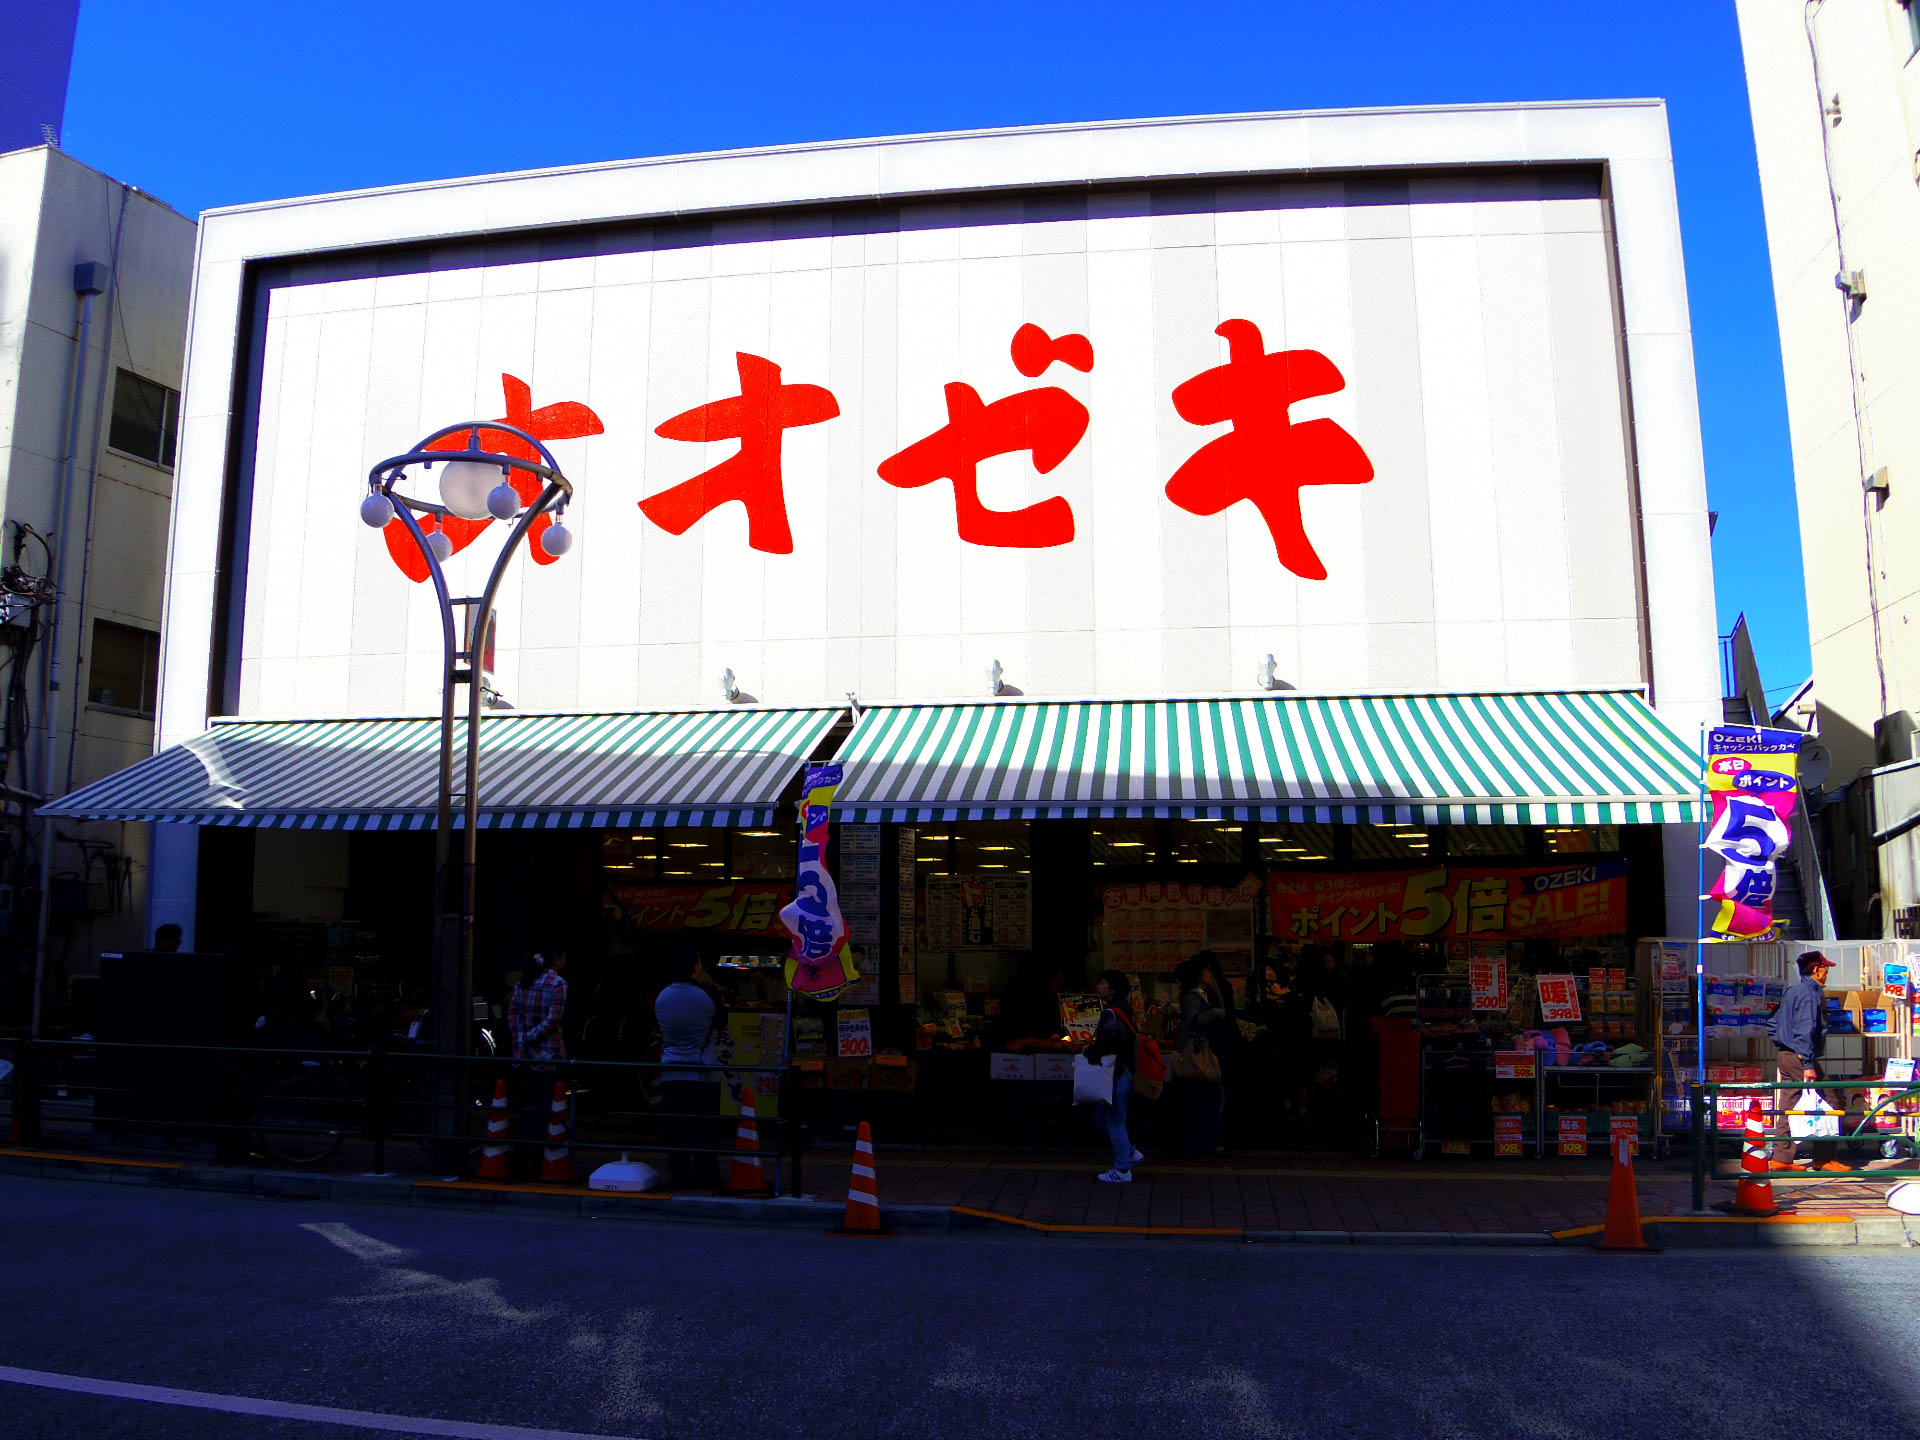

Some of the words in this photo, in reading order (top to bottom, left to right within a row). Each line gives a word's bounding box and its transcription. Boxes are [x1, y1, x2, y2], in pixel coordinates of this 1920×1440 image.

[383, 320, 1374, 580] オオゼキ
[1713, 733, 1763, 743] OZEKI
[1718, 759, 1745, 772] 本日
[1738, 774, 1790, 789] ポイント
[1533, 865, 1596, 891] OZEKI
[1510, 883, 1612, 928] SALE!
[1540, 981, 1569, 1004] 暖
[1721, 1101, 1743, 1110] scottie
